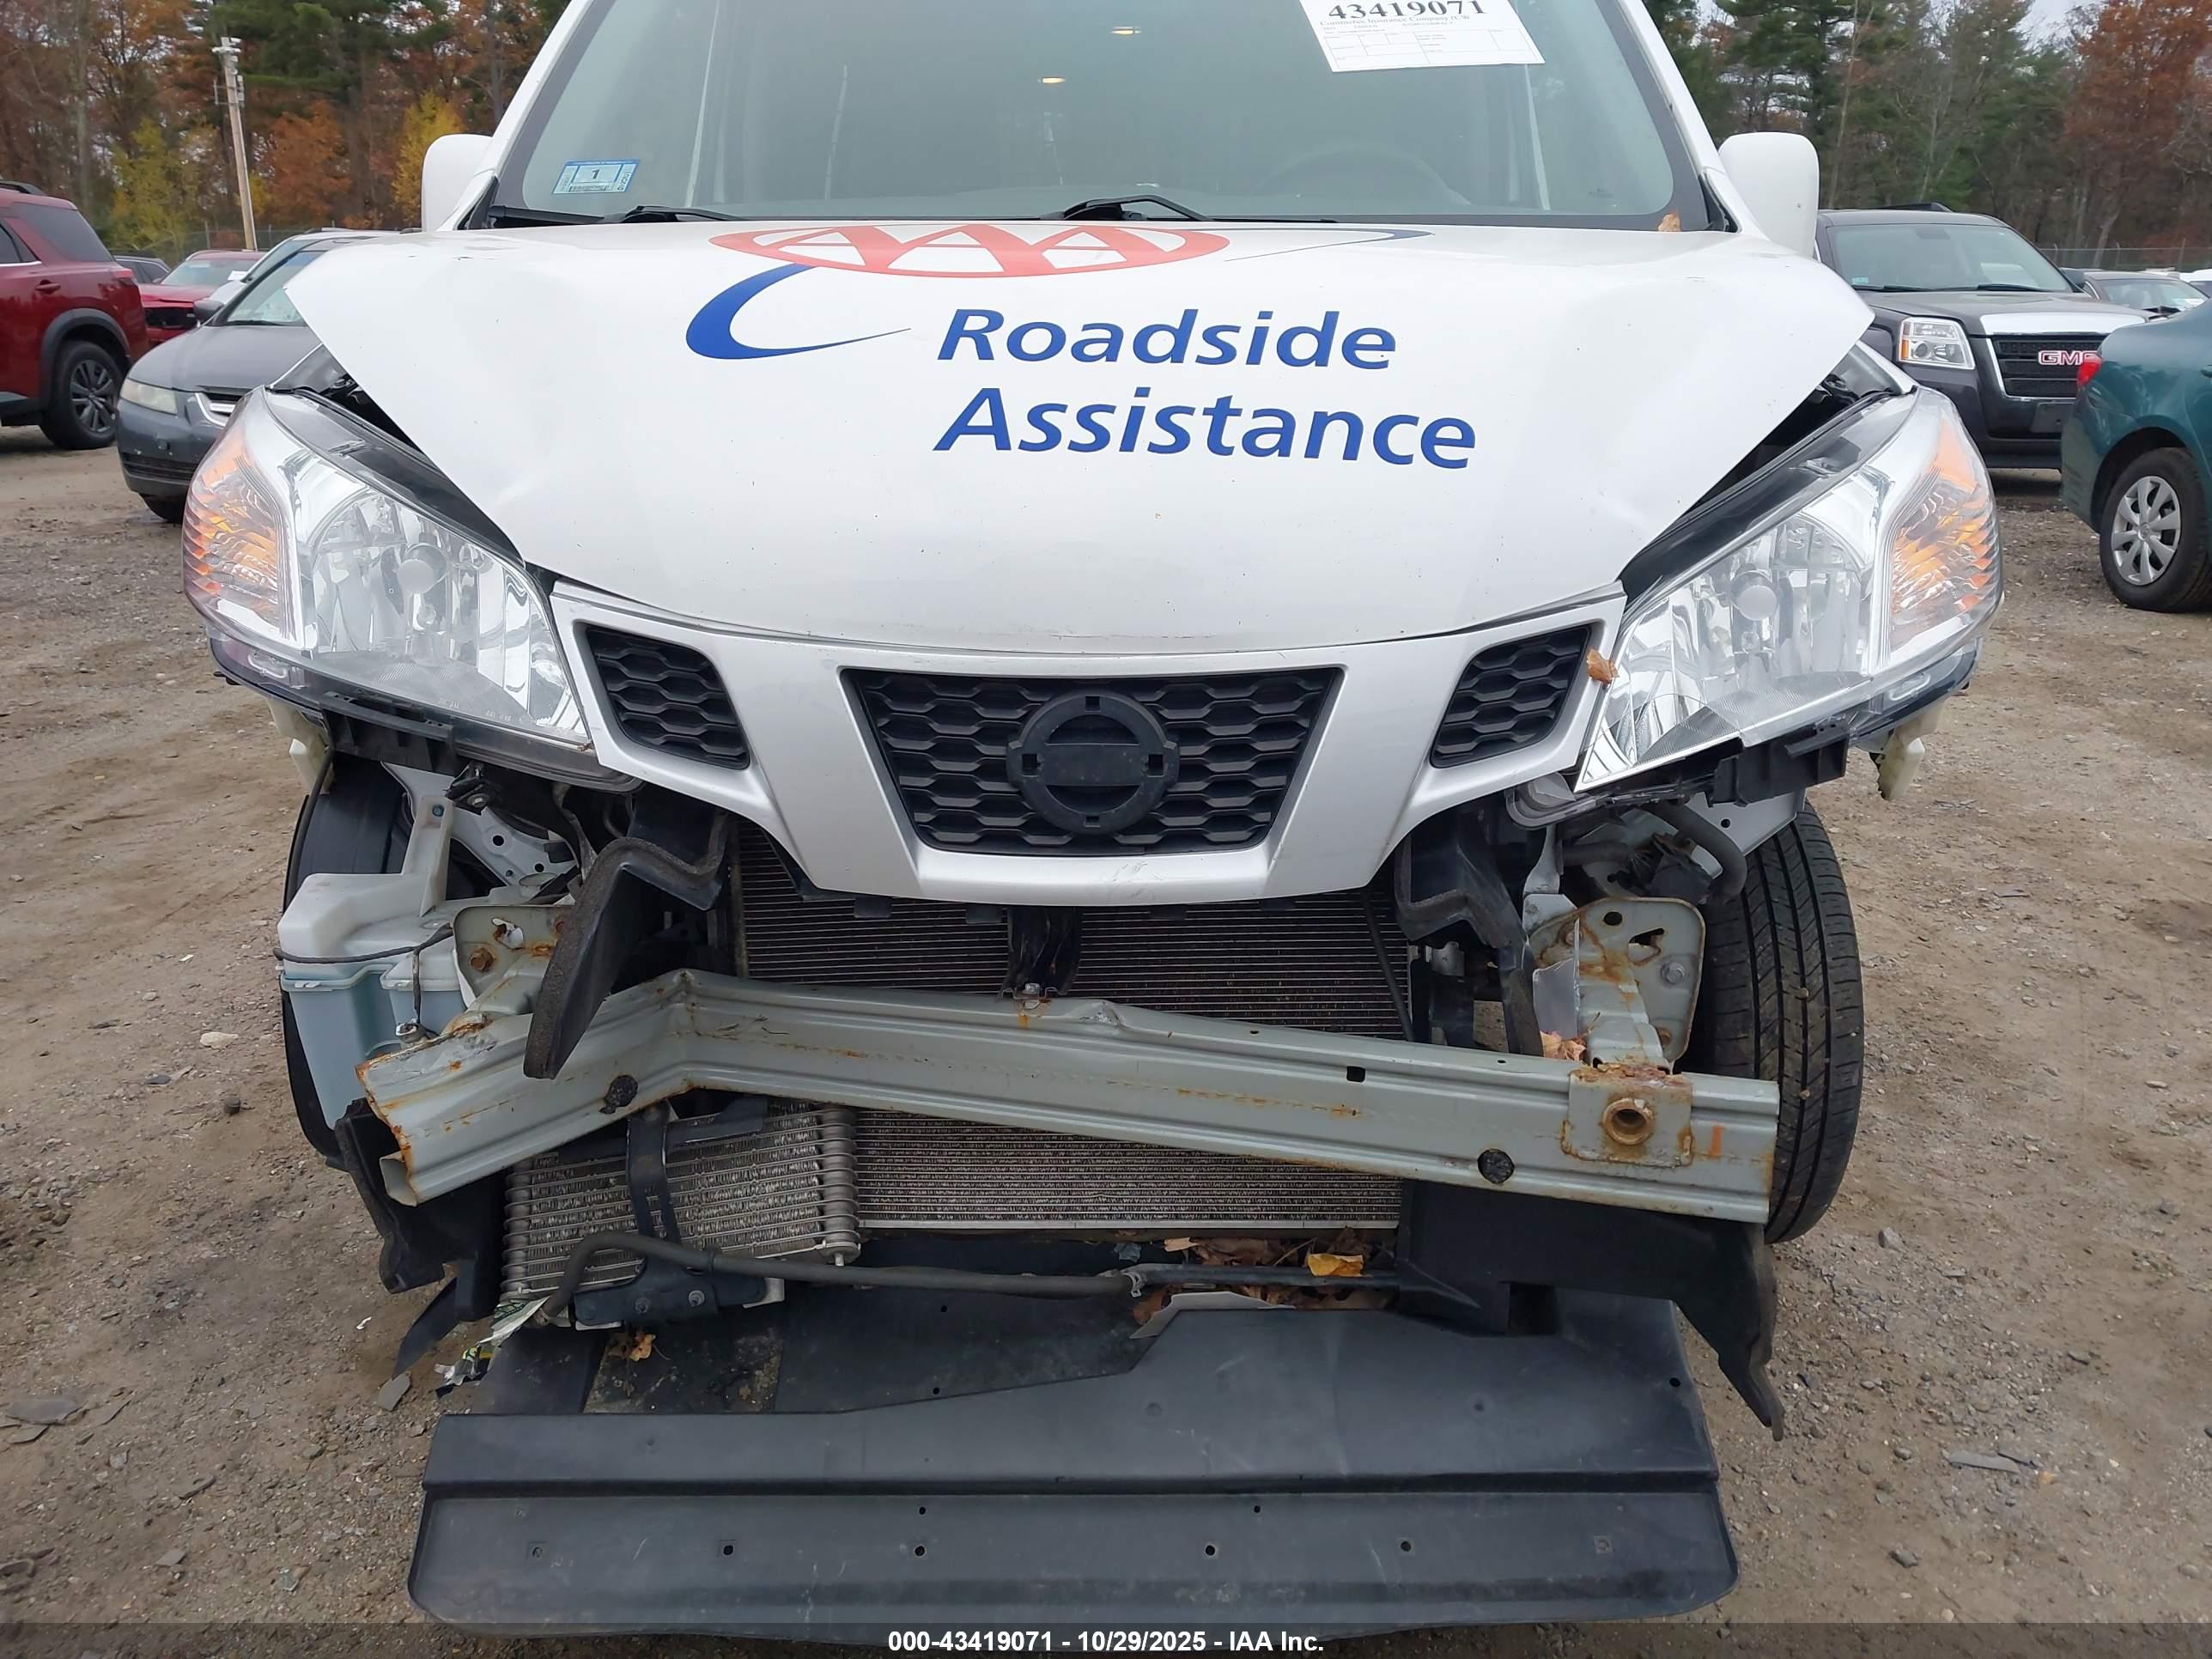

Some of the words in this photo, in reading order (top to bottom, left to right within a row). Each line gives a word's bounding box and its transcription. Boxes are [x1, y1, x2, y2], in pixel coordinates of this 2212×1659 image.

[1328, 0, 1488, 19] 43419071
[592, 168, 600, 179] 1
[730, 224, 1202, 276] AAA
[938, 308, 1396, 369] Roadside
[933, 386, 1476, 470] Assistance
